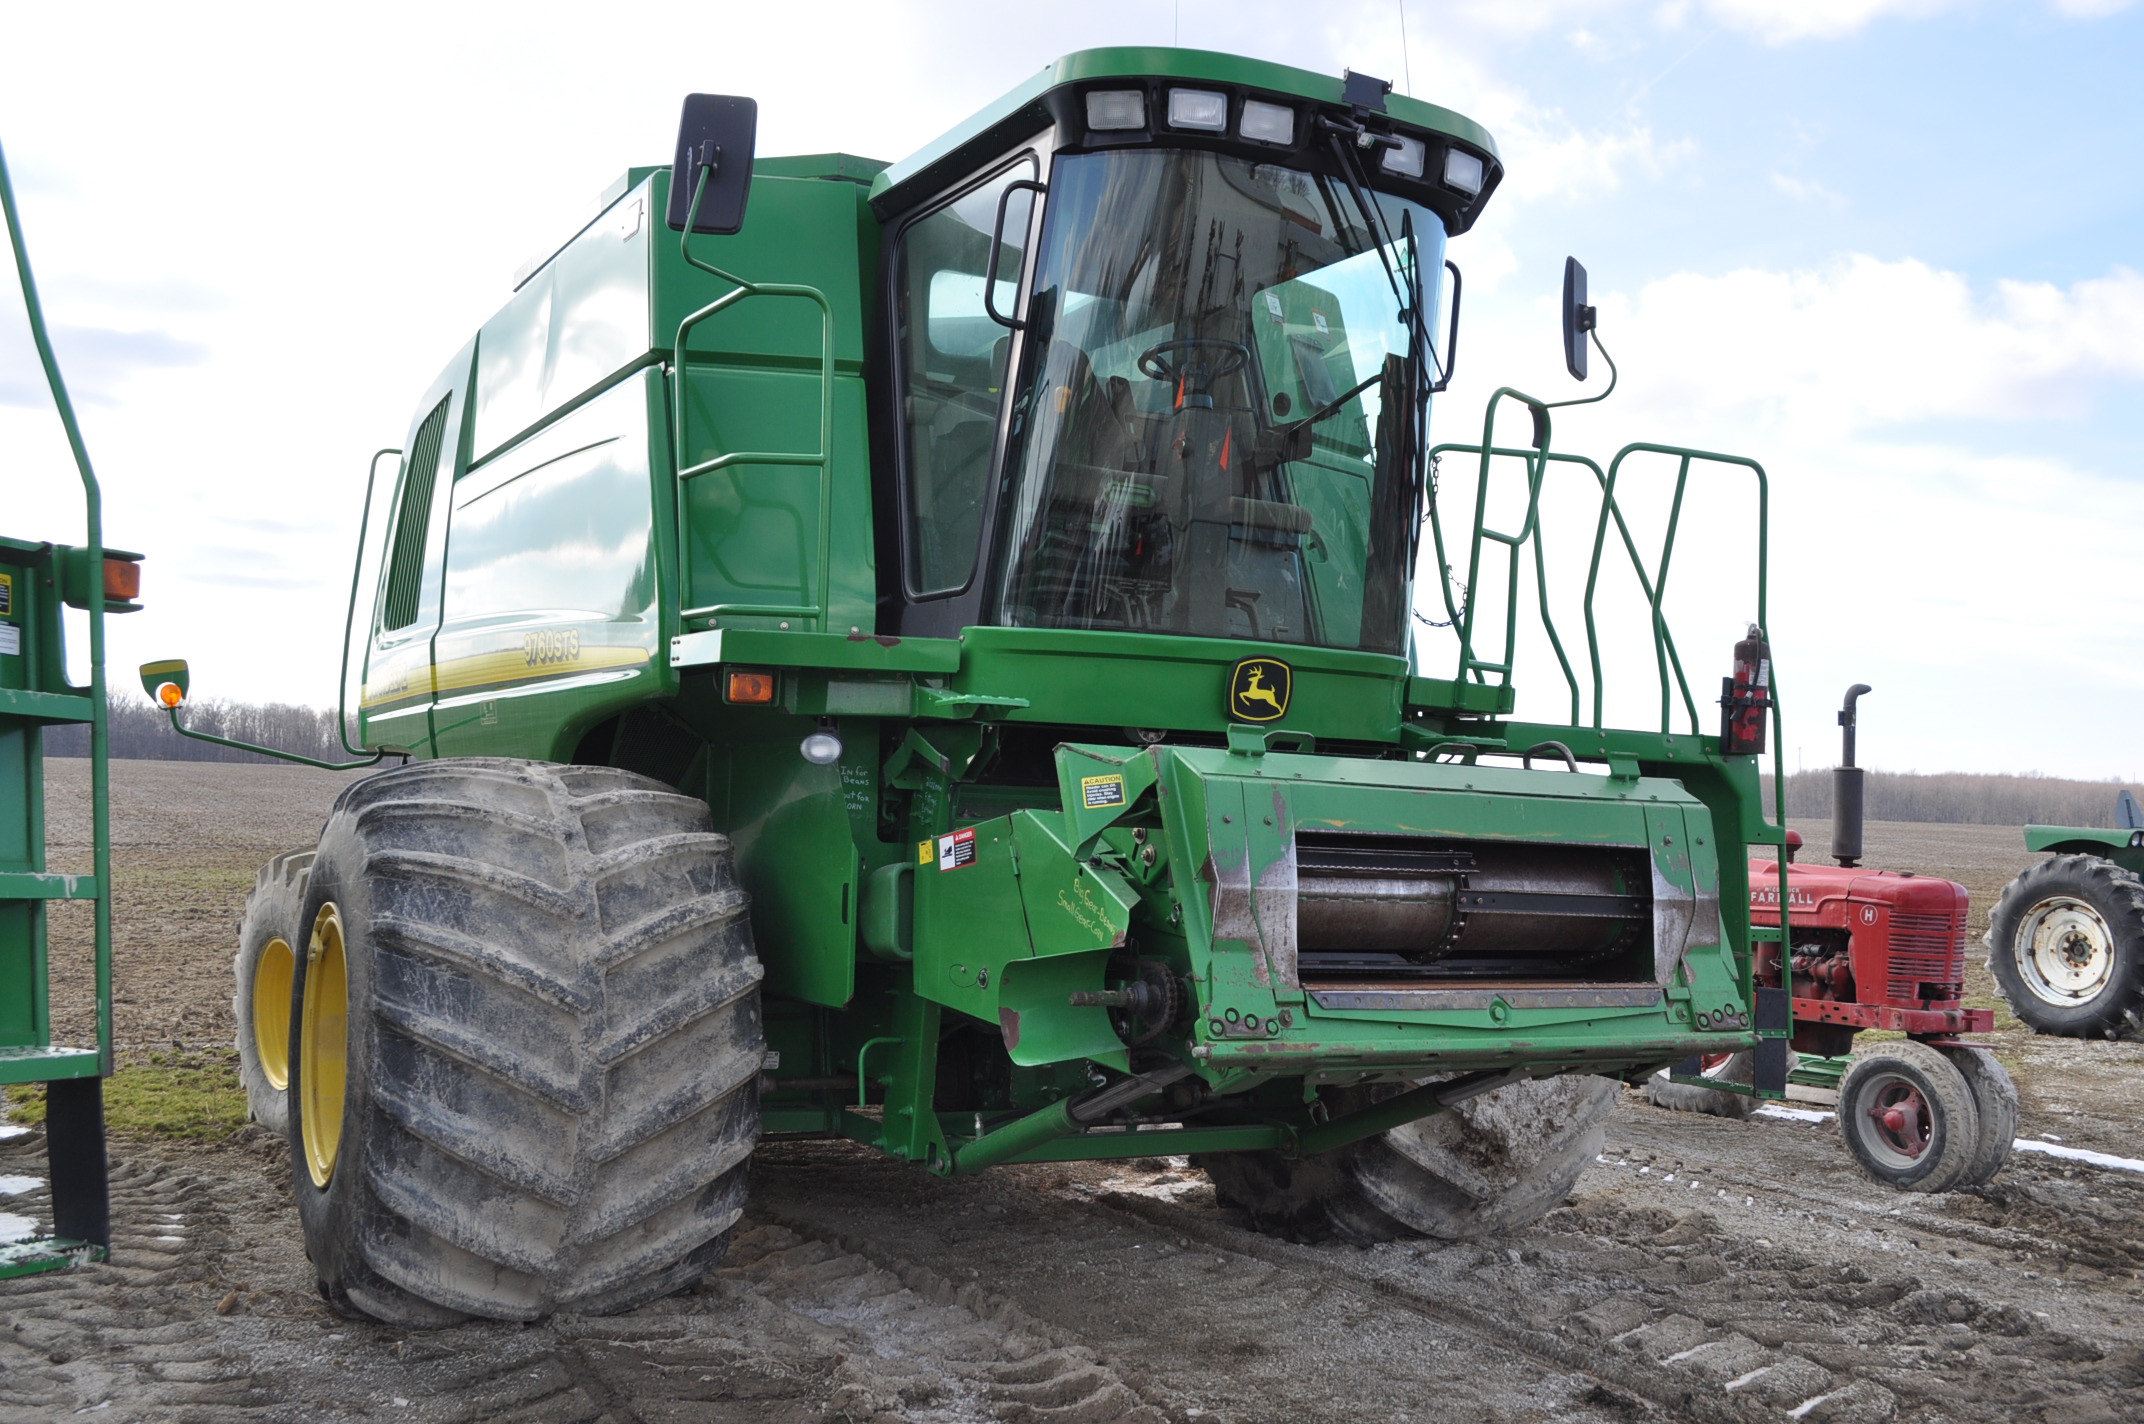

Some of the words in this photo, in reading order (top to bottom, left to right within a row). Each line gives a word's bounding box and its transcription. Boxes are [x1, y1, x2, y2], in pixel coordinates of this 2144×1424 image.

[523, 629, 580, 666] 9760STS
[1089, 776, 1120, 784] CAUTION
[844, 791, 857, 800] ut
[845, 802, 863, 811] ORN
[1073, 878, 1085, 905] Big
[1864, 909, 1873, 922] H
